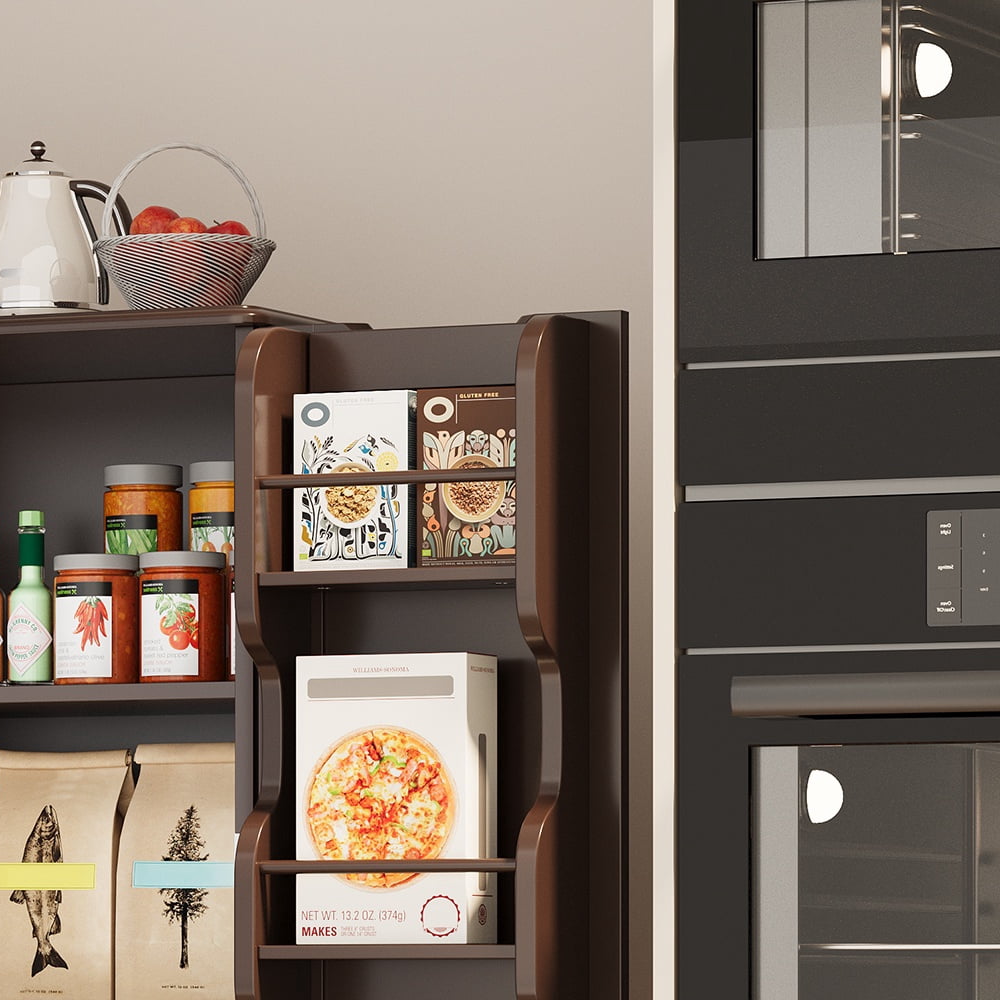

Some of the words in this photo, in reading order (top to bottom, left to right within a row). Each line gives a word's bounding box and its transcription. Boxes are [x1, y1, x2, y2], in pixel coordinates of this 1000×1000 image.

[301, 910, 319, 921] NET
[321, 910, 338, 921] WT.
[341, 910, 360, 921] 13.2
[361, 910, 377, 920] OZ.
[378, 910, 406, 922] (374g)
[301, 926, 338, 937] MAKES
